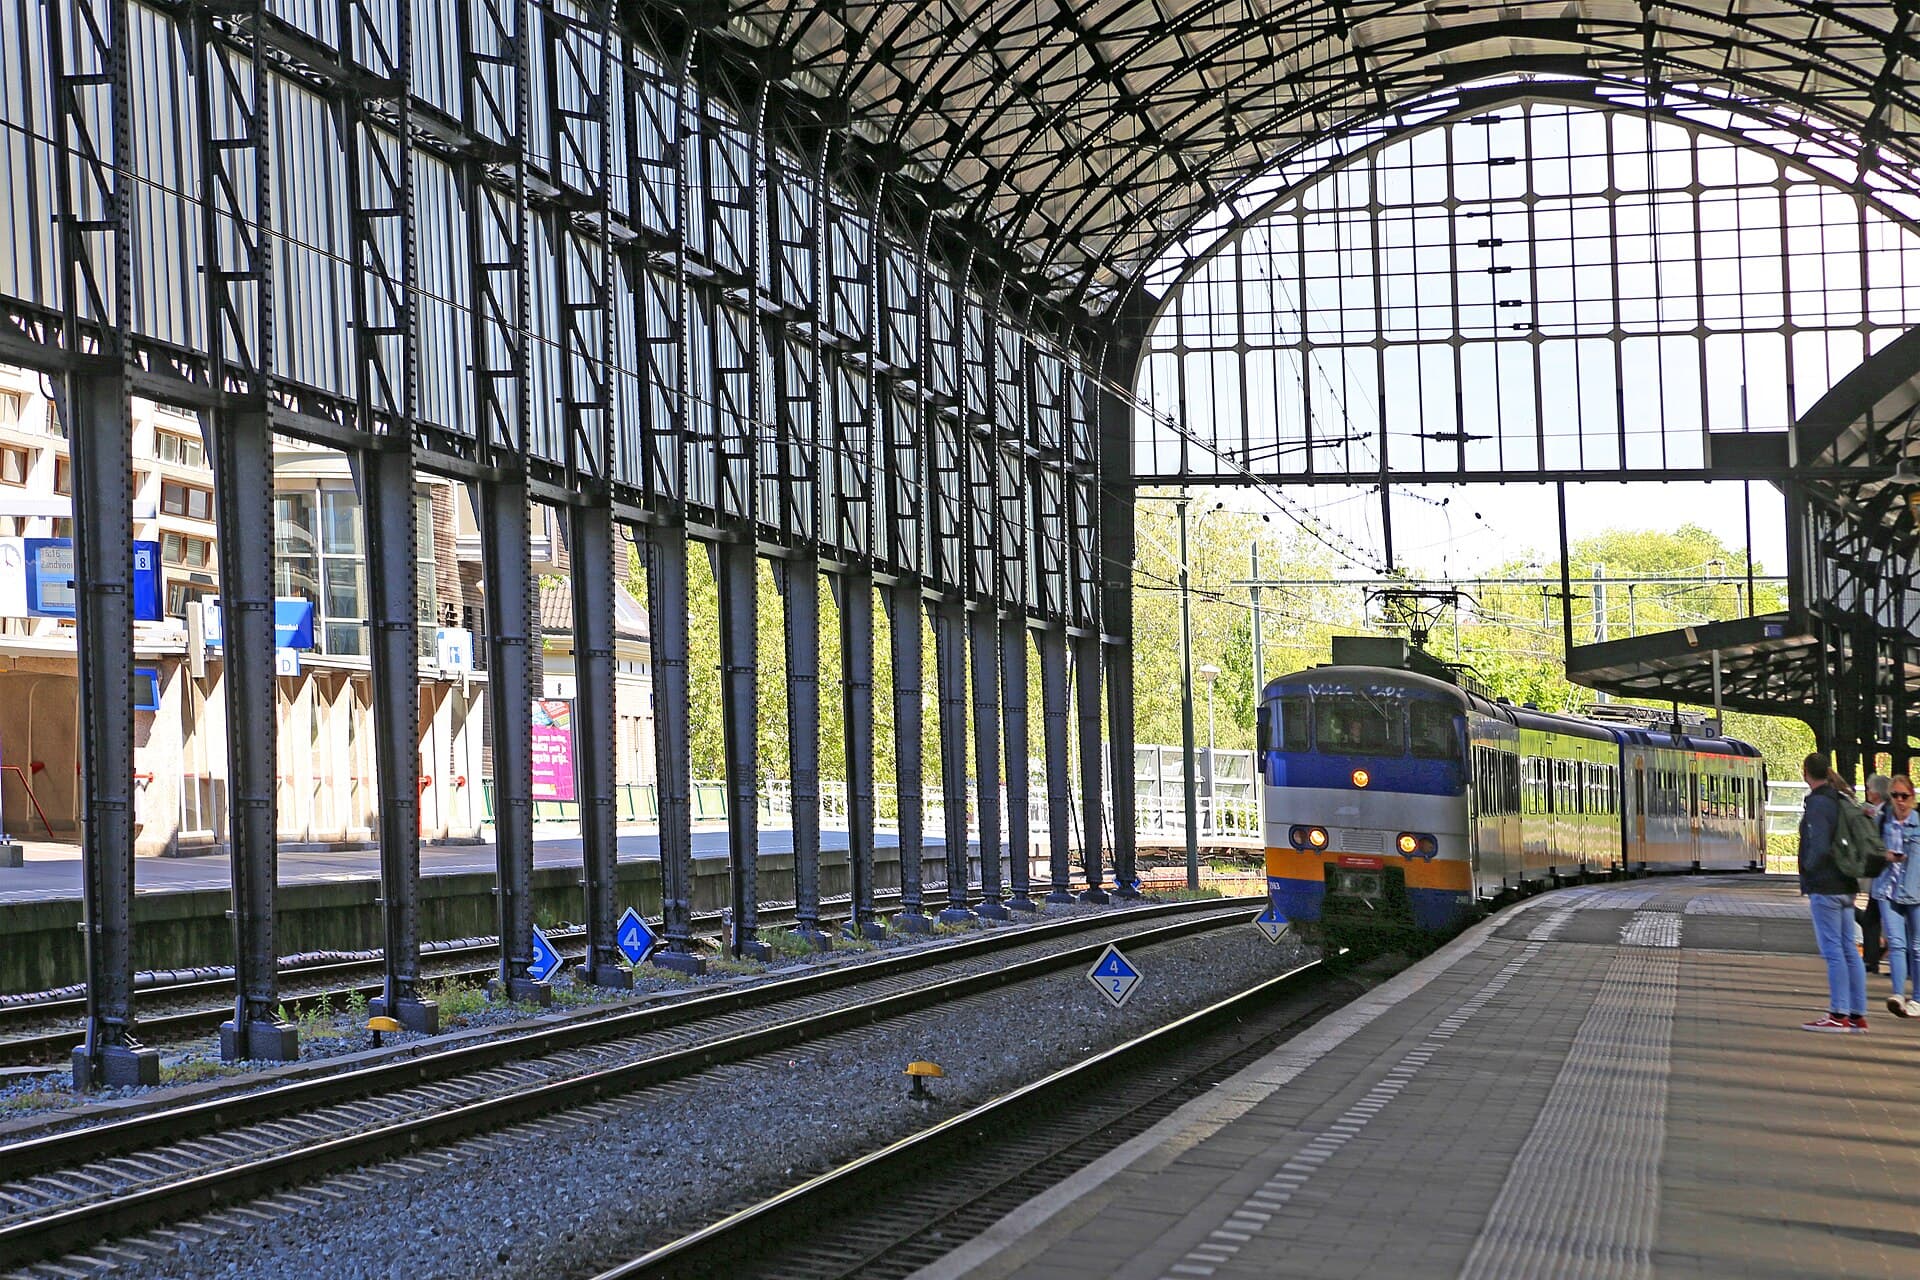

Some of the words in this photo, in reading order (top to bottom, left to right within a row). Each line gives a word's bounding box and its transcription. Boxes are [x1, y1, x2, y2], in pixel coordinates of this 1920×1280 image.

[140, 557, 146, 569] 8
[282, 659, 291, 672] D
[1706, 728, 1715, 738] D
[1271, 924, 1277, 934] 3
[623, 927, 641, 951] 4
[1109, 960, 1119, 973] 4
[1112, 979, 1120, 992] 2
